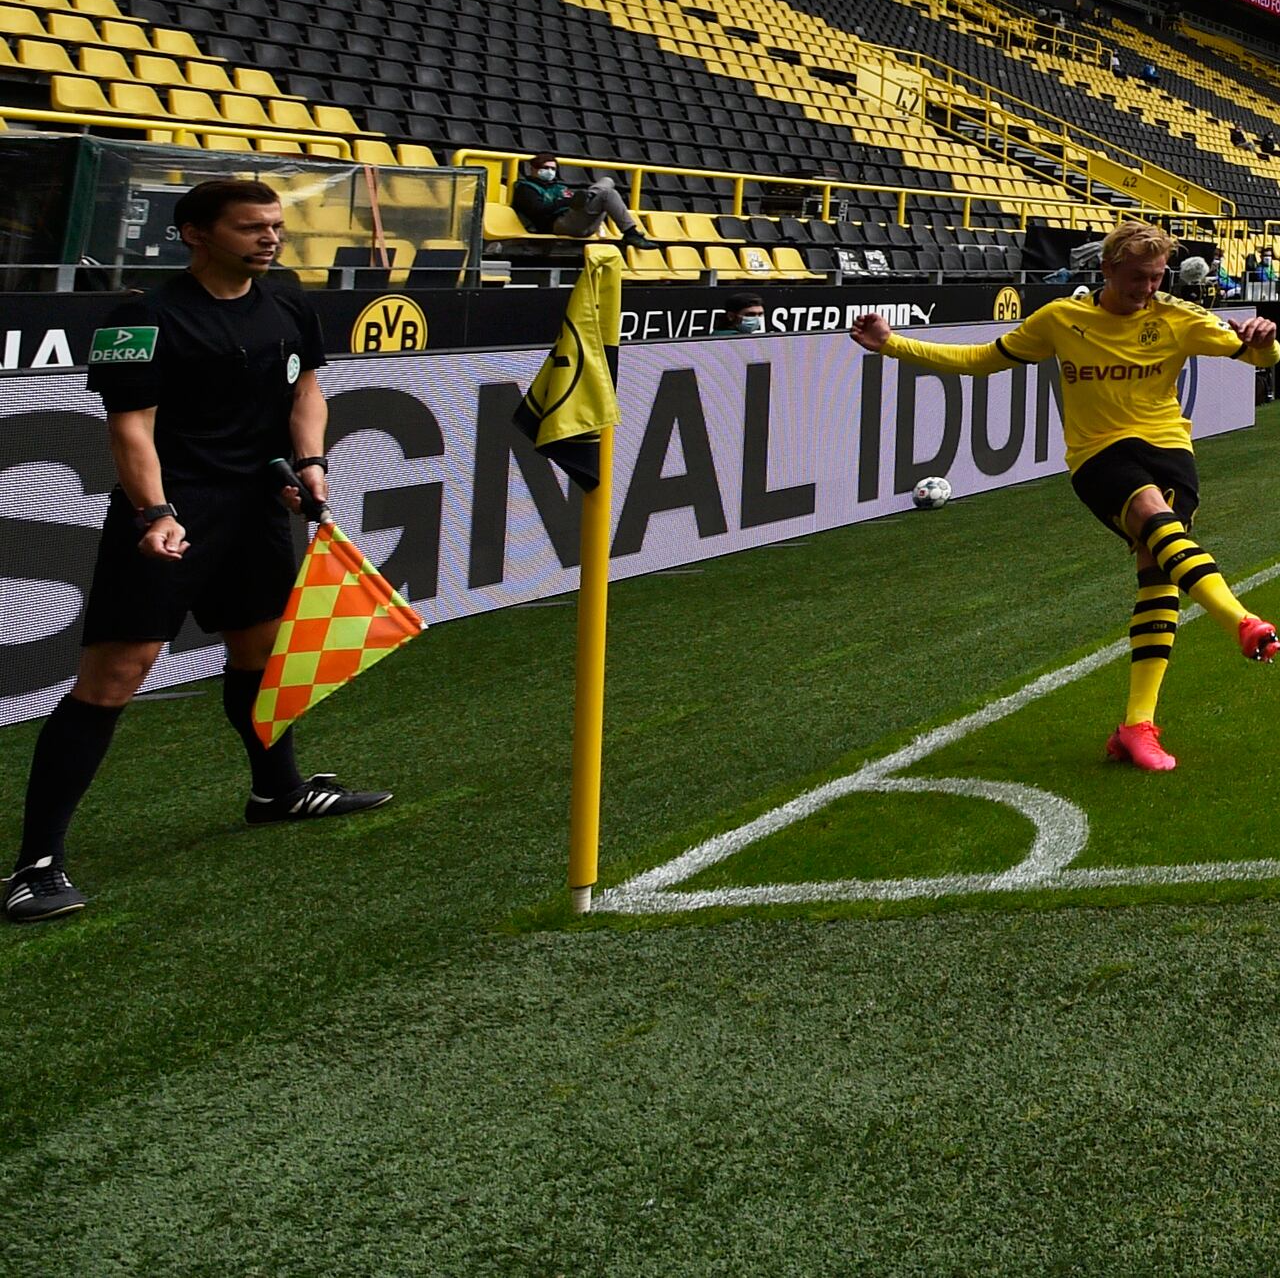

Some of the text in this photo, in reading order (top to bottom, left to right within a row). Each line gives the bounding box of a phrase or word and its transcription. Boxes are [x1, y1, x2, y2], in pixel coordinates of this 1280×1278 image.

[1121, 176, 1138, 188] 42
[998, 292, 1018, 320] BVB
[363, 305, 419, 352] BVB
[90, 347, 149, 362] DEKRA
[1079, 361, 1163, 382] EVONIK
[0, 362, 816, 700] SGNAL
